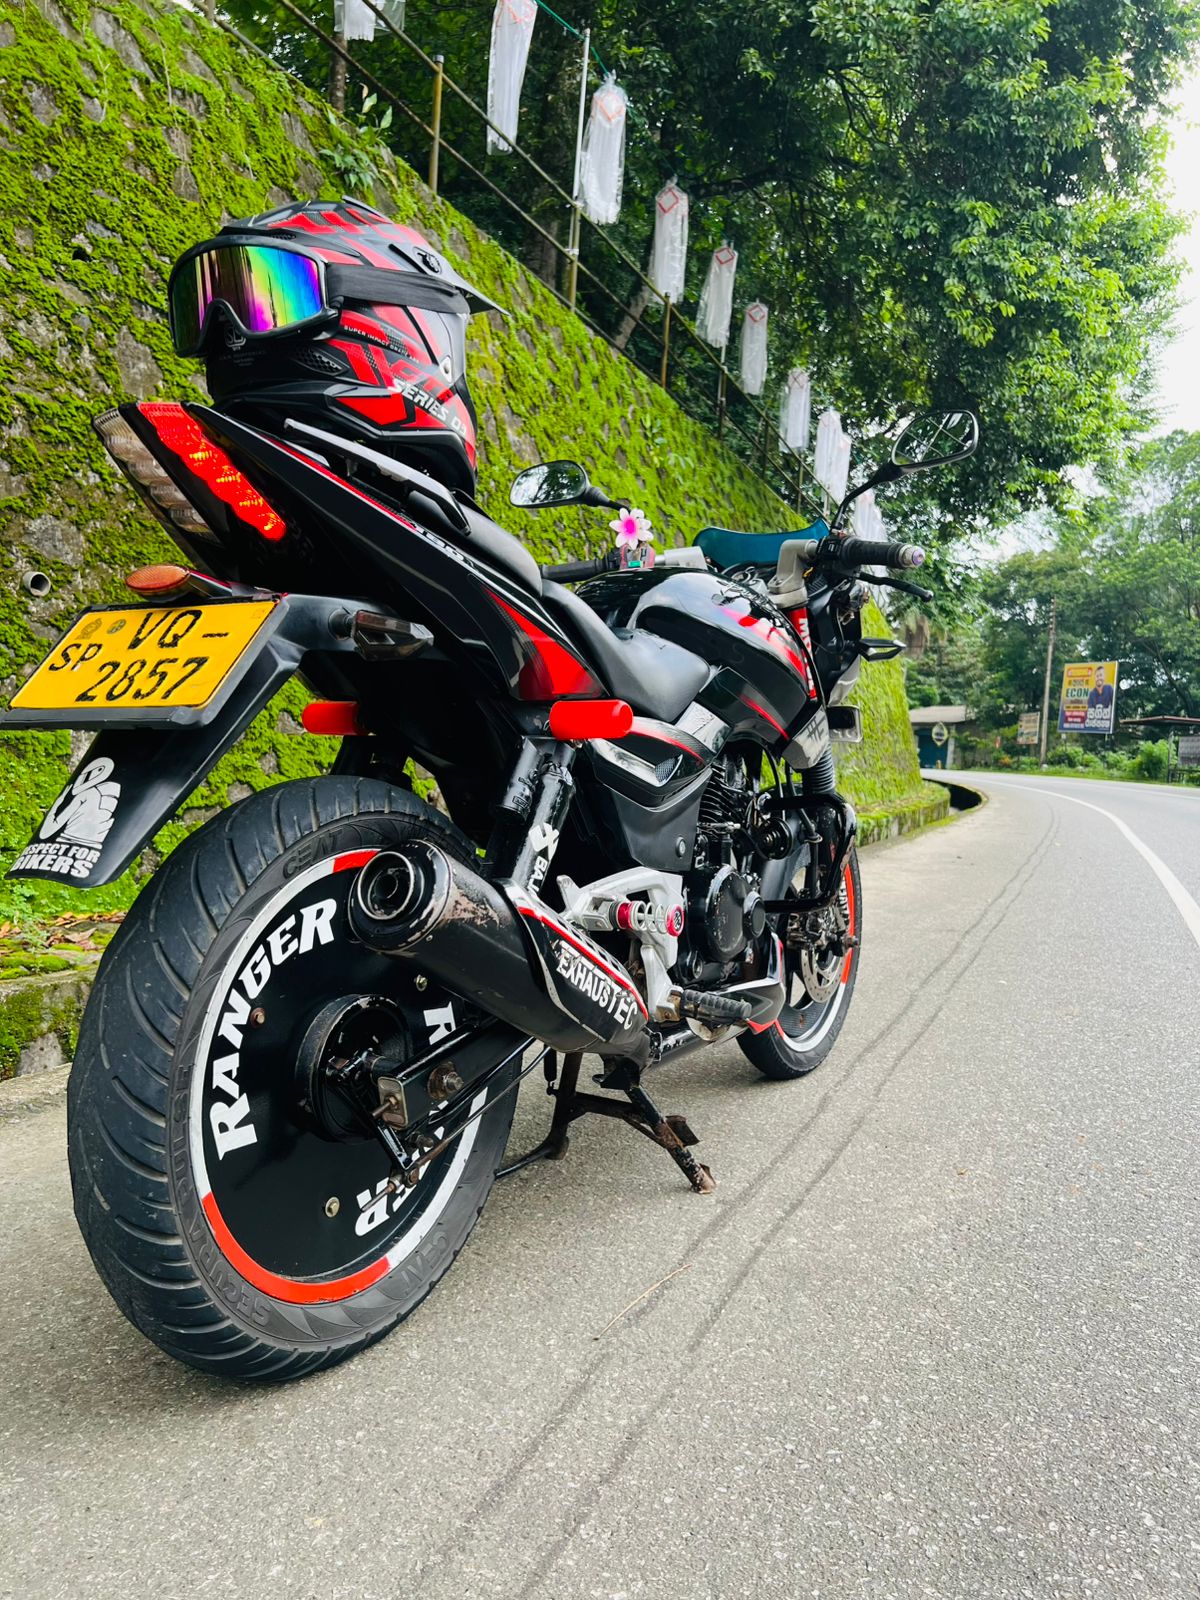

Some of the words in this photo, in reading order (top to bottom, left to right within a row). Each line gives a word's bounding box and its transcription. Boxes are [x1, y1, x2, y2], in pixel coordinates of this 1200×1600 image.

[344, 325, 367, 337] SUPER
[387, 377, 449, 421] SERIES
[48, 643, 103, 672] SP
[75, 656, 209, 702] 2857
[67, 845, 101, 864] FOR
[526, 855, 549, 893] BAJ
[556, 948, 638, 1031] EXHAUSTEC
[209, 898, 338, 1161] RANGER
